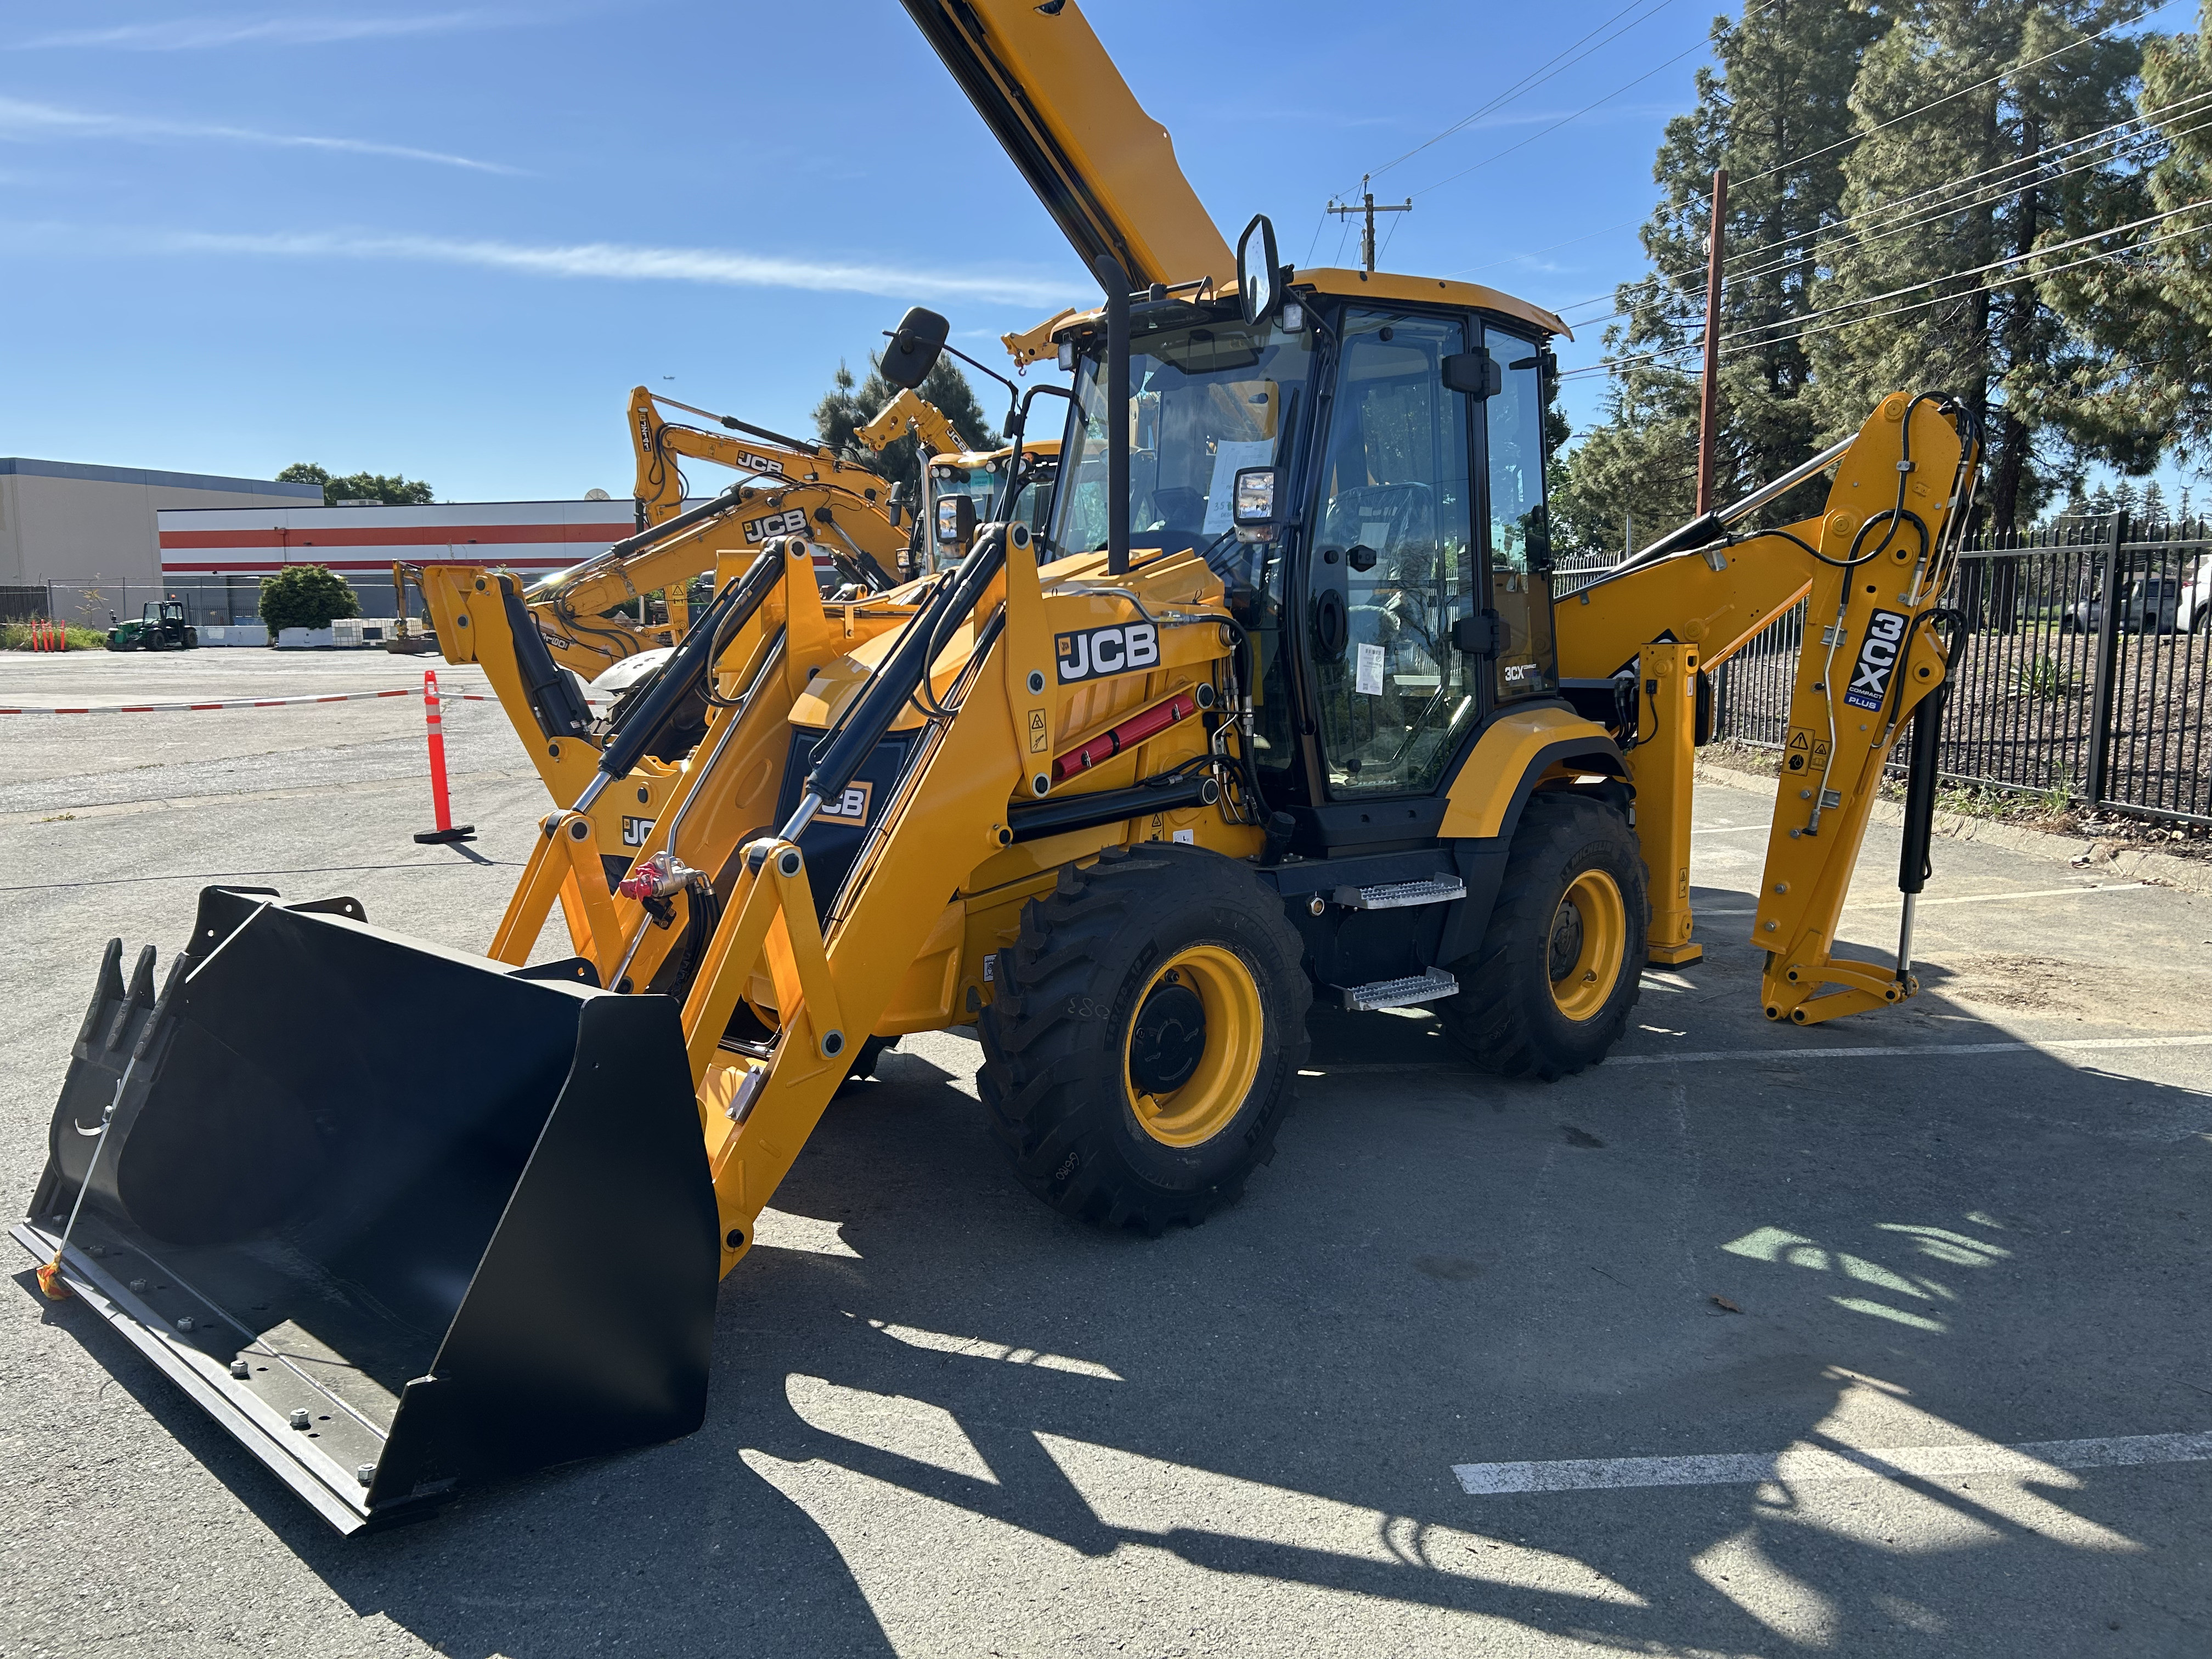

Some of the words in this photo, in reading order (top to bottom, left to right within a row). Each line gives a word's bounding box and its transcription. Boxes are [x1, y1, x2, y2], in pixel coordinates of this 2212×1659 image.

[946, 430, 967, 454] JCB
[737, 454, 783, 473] JCB
[746, 509, 807, 542] JCB
[1059, 623, 1158, 680] JCB
[1850, 613, 1904, 693] 3CX
[1504, 665, 1525, 681] 3CX
[1848, 686, 1883, 699] COMPACT
[1848, 696, 1877, 709] PLUS
[624, 819, 655, 844] JC
